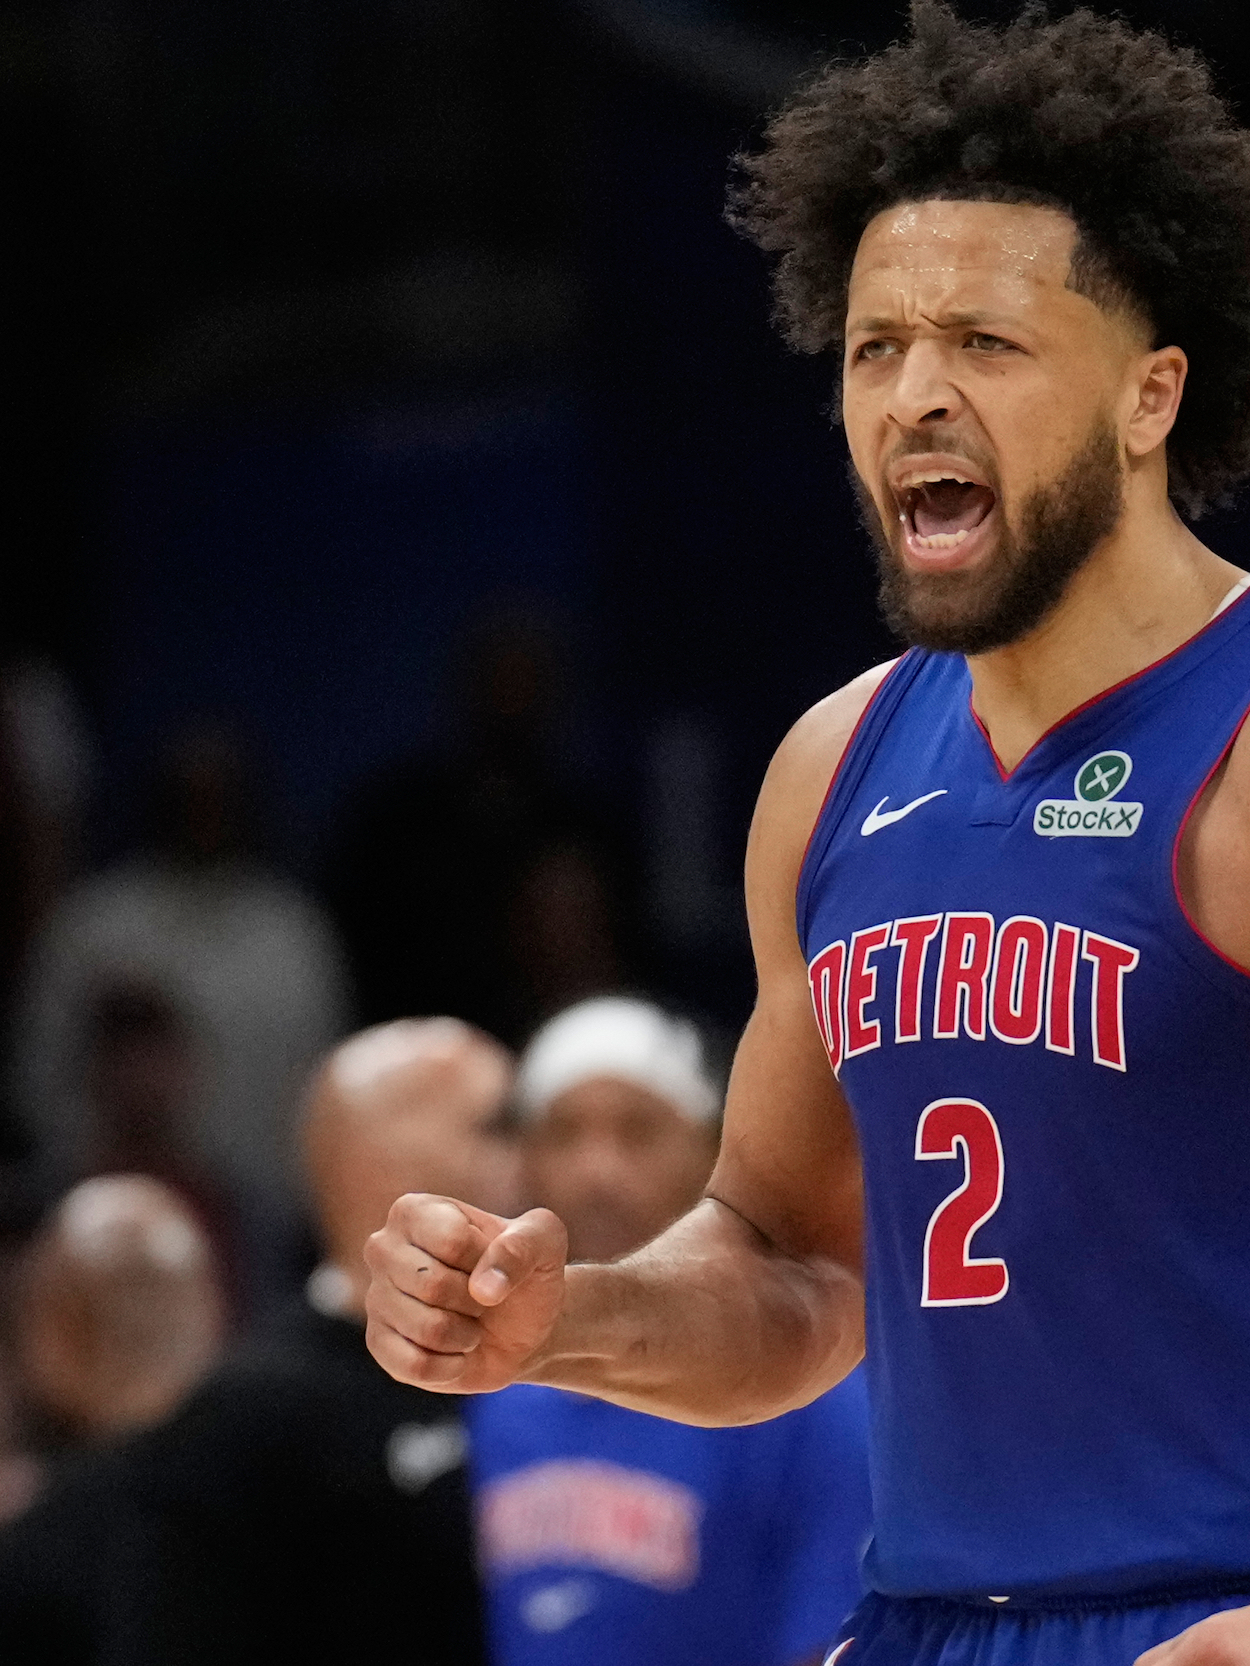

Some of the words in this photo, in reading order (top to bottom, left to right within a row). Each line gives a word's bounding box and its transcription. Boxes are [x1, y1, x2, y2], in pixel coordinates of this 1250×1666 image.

[1038, 805, 1138, 830] StockX
[808, 911, 1140, 1081] DETROIT
[915, 1097, 1010, 1308] 2
